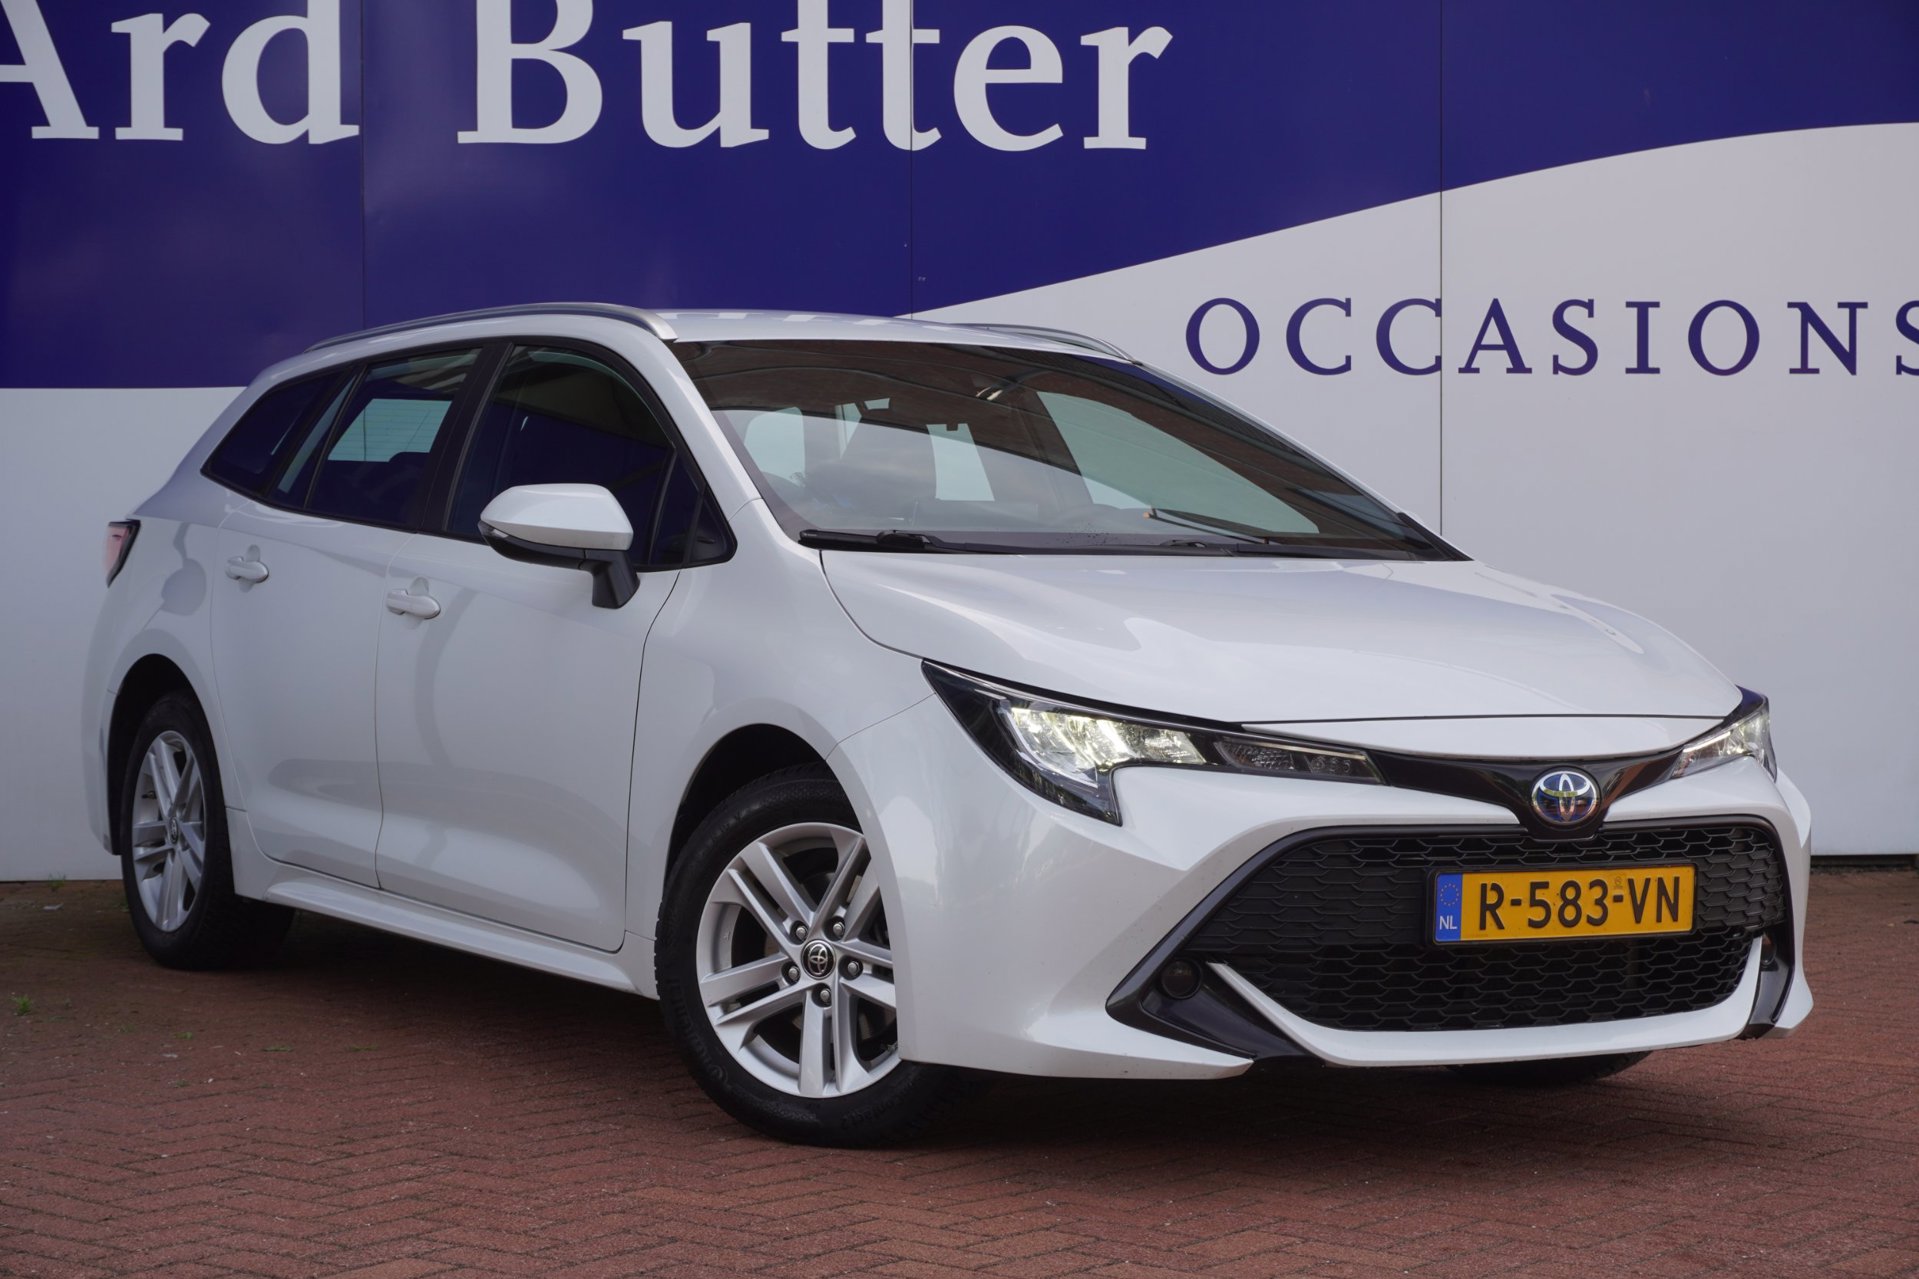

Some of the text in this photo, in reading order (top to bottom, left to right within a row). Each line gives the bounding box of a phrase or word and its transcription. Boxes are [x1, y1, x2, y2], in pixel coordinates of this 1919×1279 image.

[457, 0, 1173, 151] Butter
[1439, 915, 1458, 931] NL
[1479, 876, 1680, 931] R-583-VN
